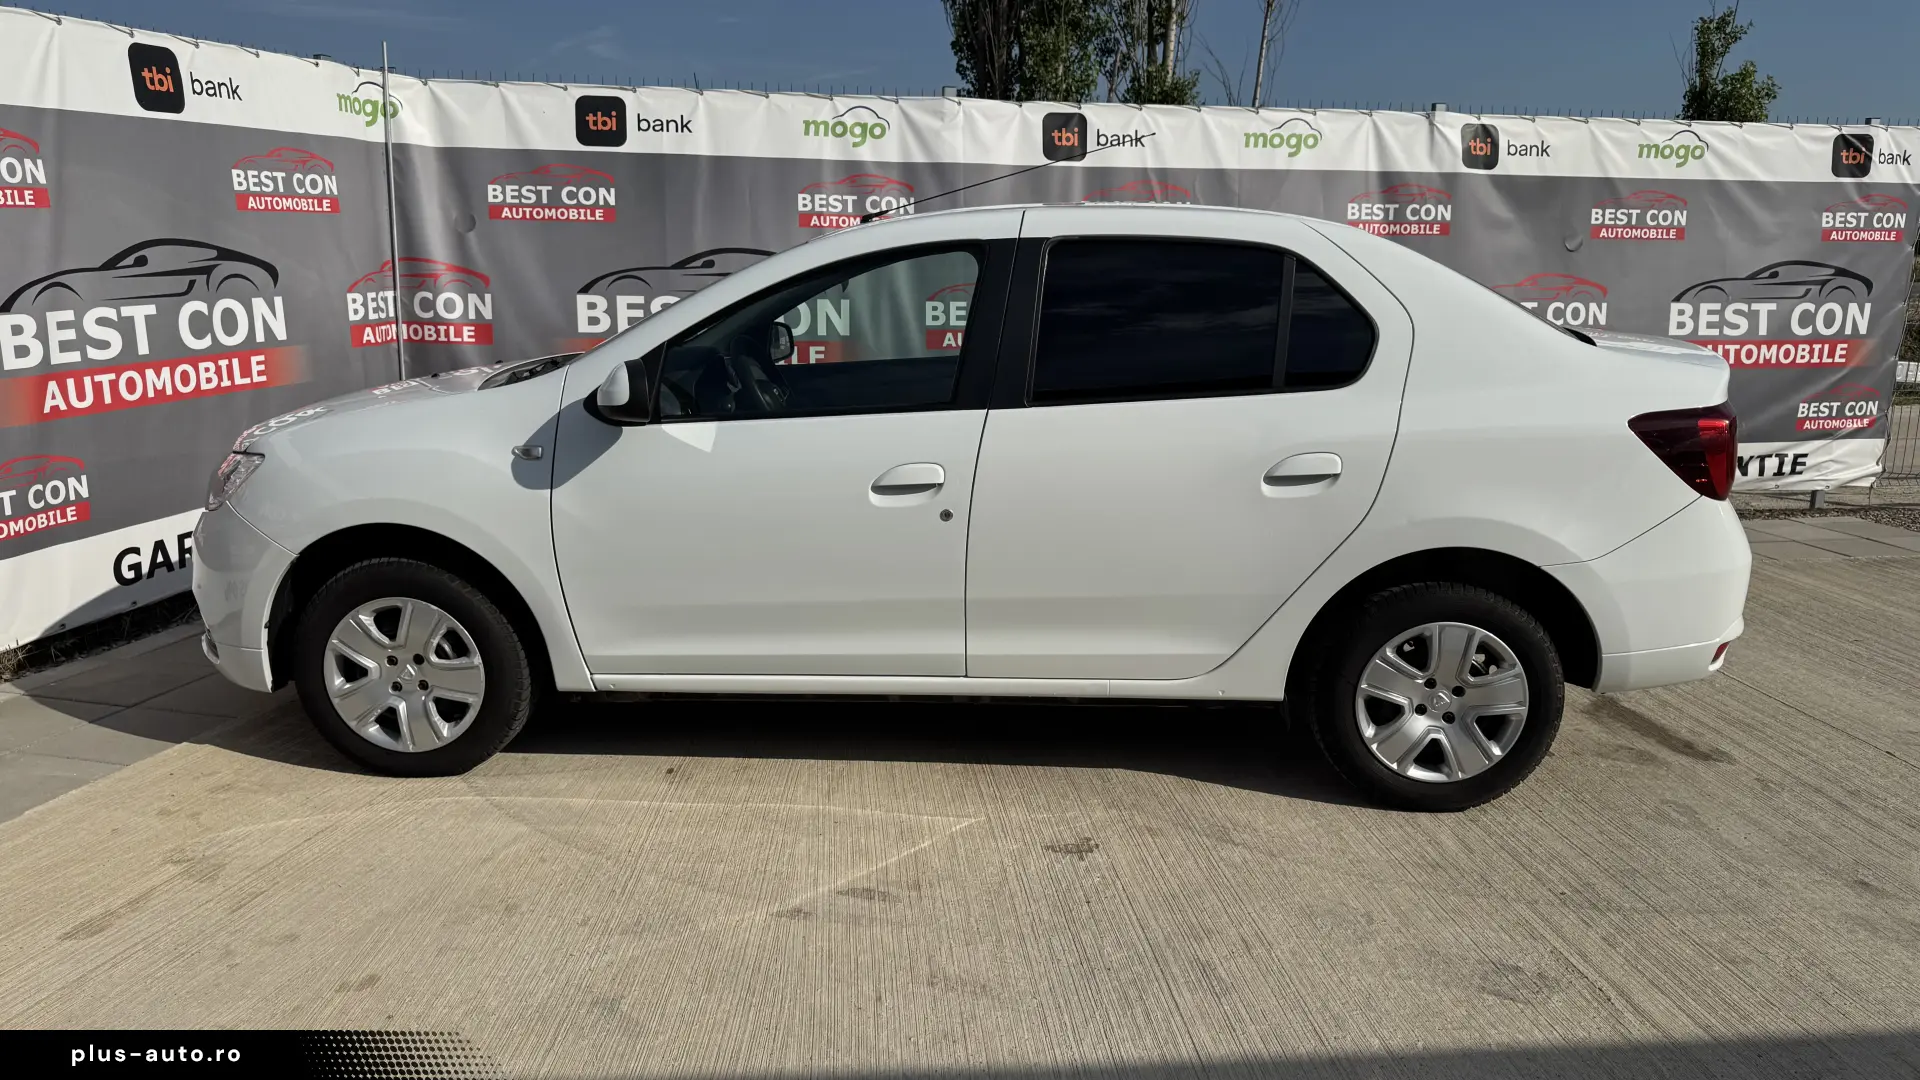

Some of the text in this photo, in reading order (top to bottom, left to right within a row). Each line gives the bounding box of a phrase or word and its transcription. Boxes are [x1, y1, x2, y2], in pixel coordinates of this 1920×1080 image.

[141, 66, 243, 101] tbi bank
[336, 93, 400, 127] mogo
[585, 111, 693, 133] tbi bank
[803, 119, 887, 148] mogo
[1052, 128, 1145, 147] tbi bank
[1244, 128, 1319, 157] mogo
[1468, 137, 1551, 157] tbi bank
[1637, 142, 1705, 168] mogo
[1841, 147, 1912, 166] tbi bank
[231, 168, 338, 195] BEST CON
[248, 196, 331, 211] AUTOMOBILE
[487, 184, 616, 206] BEST CON
[797, 193, 915, 215] BEST CON
[501, 207, 604, 220] AUTOMOBILE
[1347, 203, 1452, 221] BEST CON
[1590, 208, 1688, 226] BEST CON
[1821, 212, 1907, 229] BEST CON
[1599, 228, 1677, 239] AUTOMOBILE
[1830, 230, 1897, 241] AUTOMOBILE
[346, 290, 493, 321] BEST CON
[1546, 301, 1608, 326] CON
[1668, 302, 1872, 336] BEST CON
[0, 296, 288, 370] BEST CON
[363, 323, 476, 344] AUTOMOBILE
[43, 355, 267, 414] AUTOMOBILE
[1797, 400, 1879, 418] BEST CON
[1803, 418, 1869, 430] AUTOMOBILE
[27, 474, 89, 510] CON
